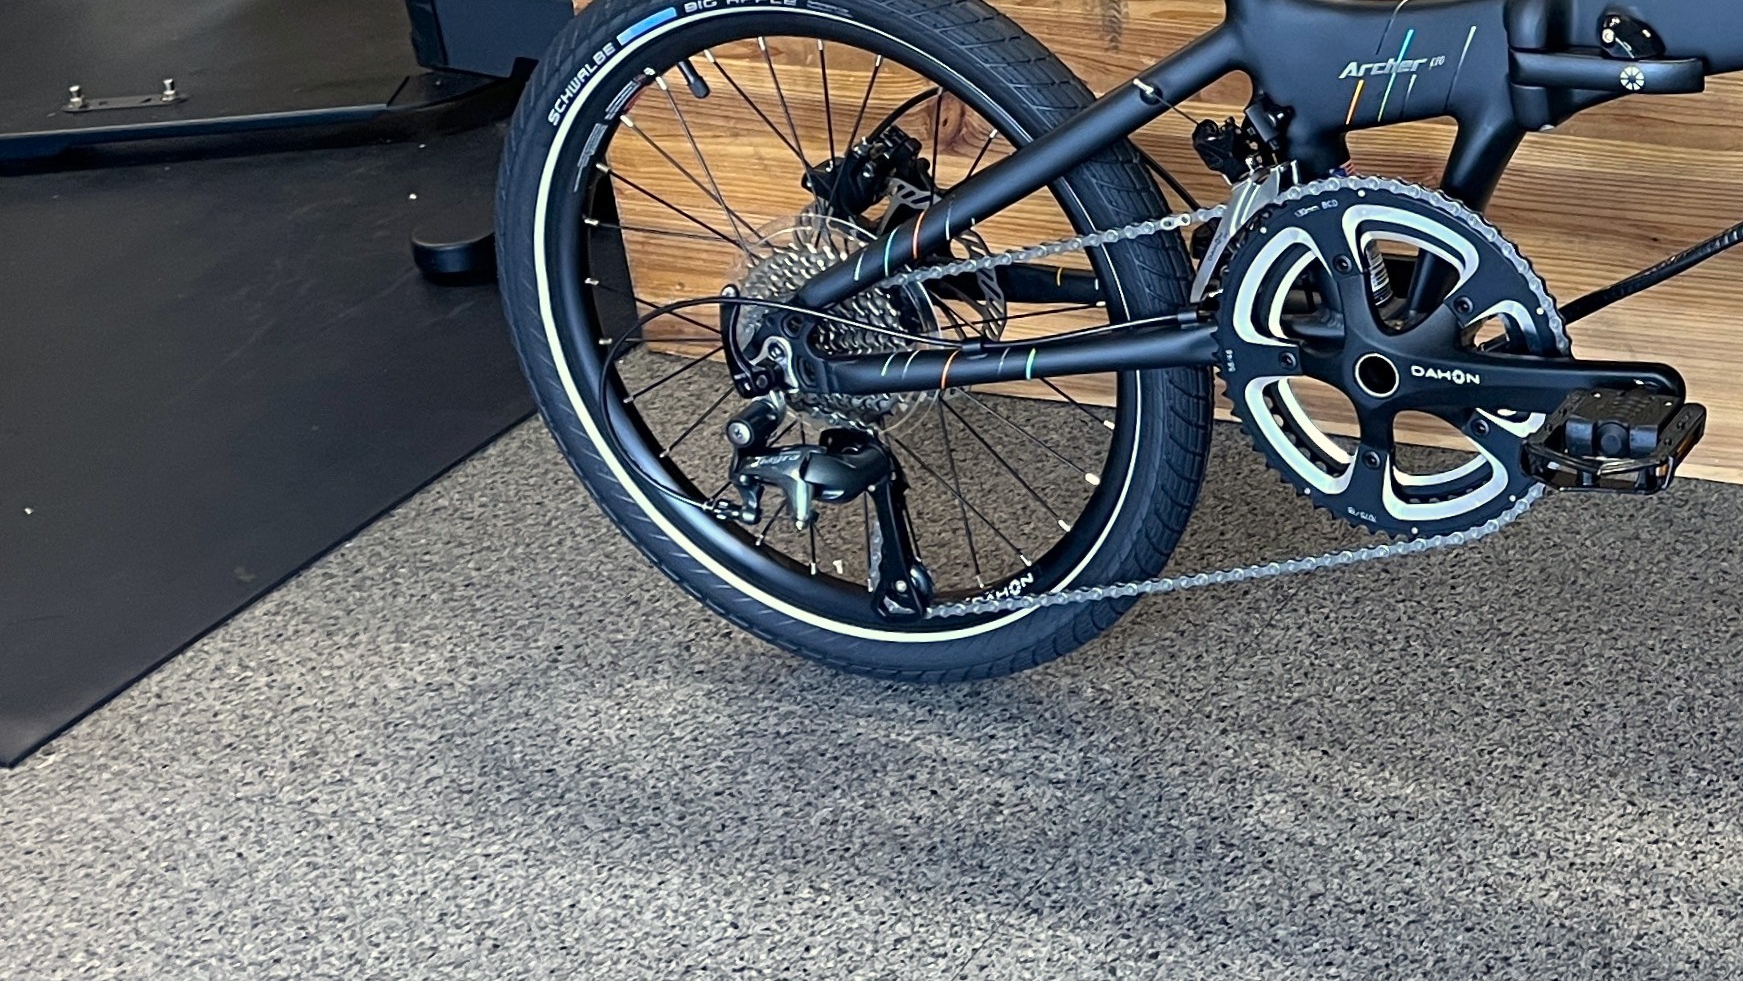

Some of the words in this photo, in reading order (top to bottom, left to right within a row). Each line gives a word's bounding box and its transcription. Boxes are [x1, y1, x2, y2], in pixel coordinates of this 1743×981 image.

[1338, 57, 1428, 79] Archer
[547, 42, 617, 127] SCHWALBE
[1410, 365, 1480, 385] DAHON
[971, 572, 1034, 602] AHON
